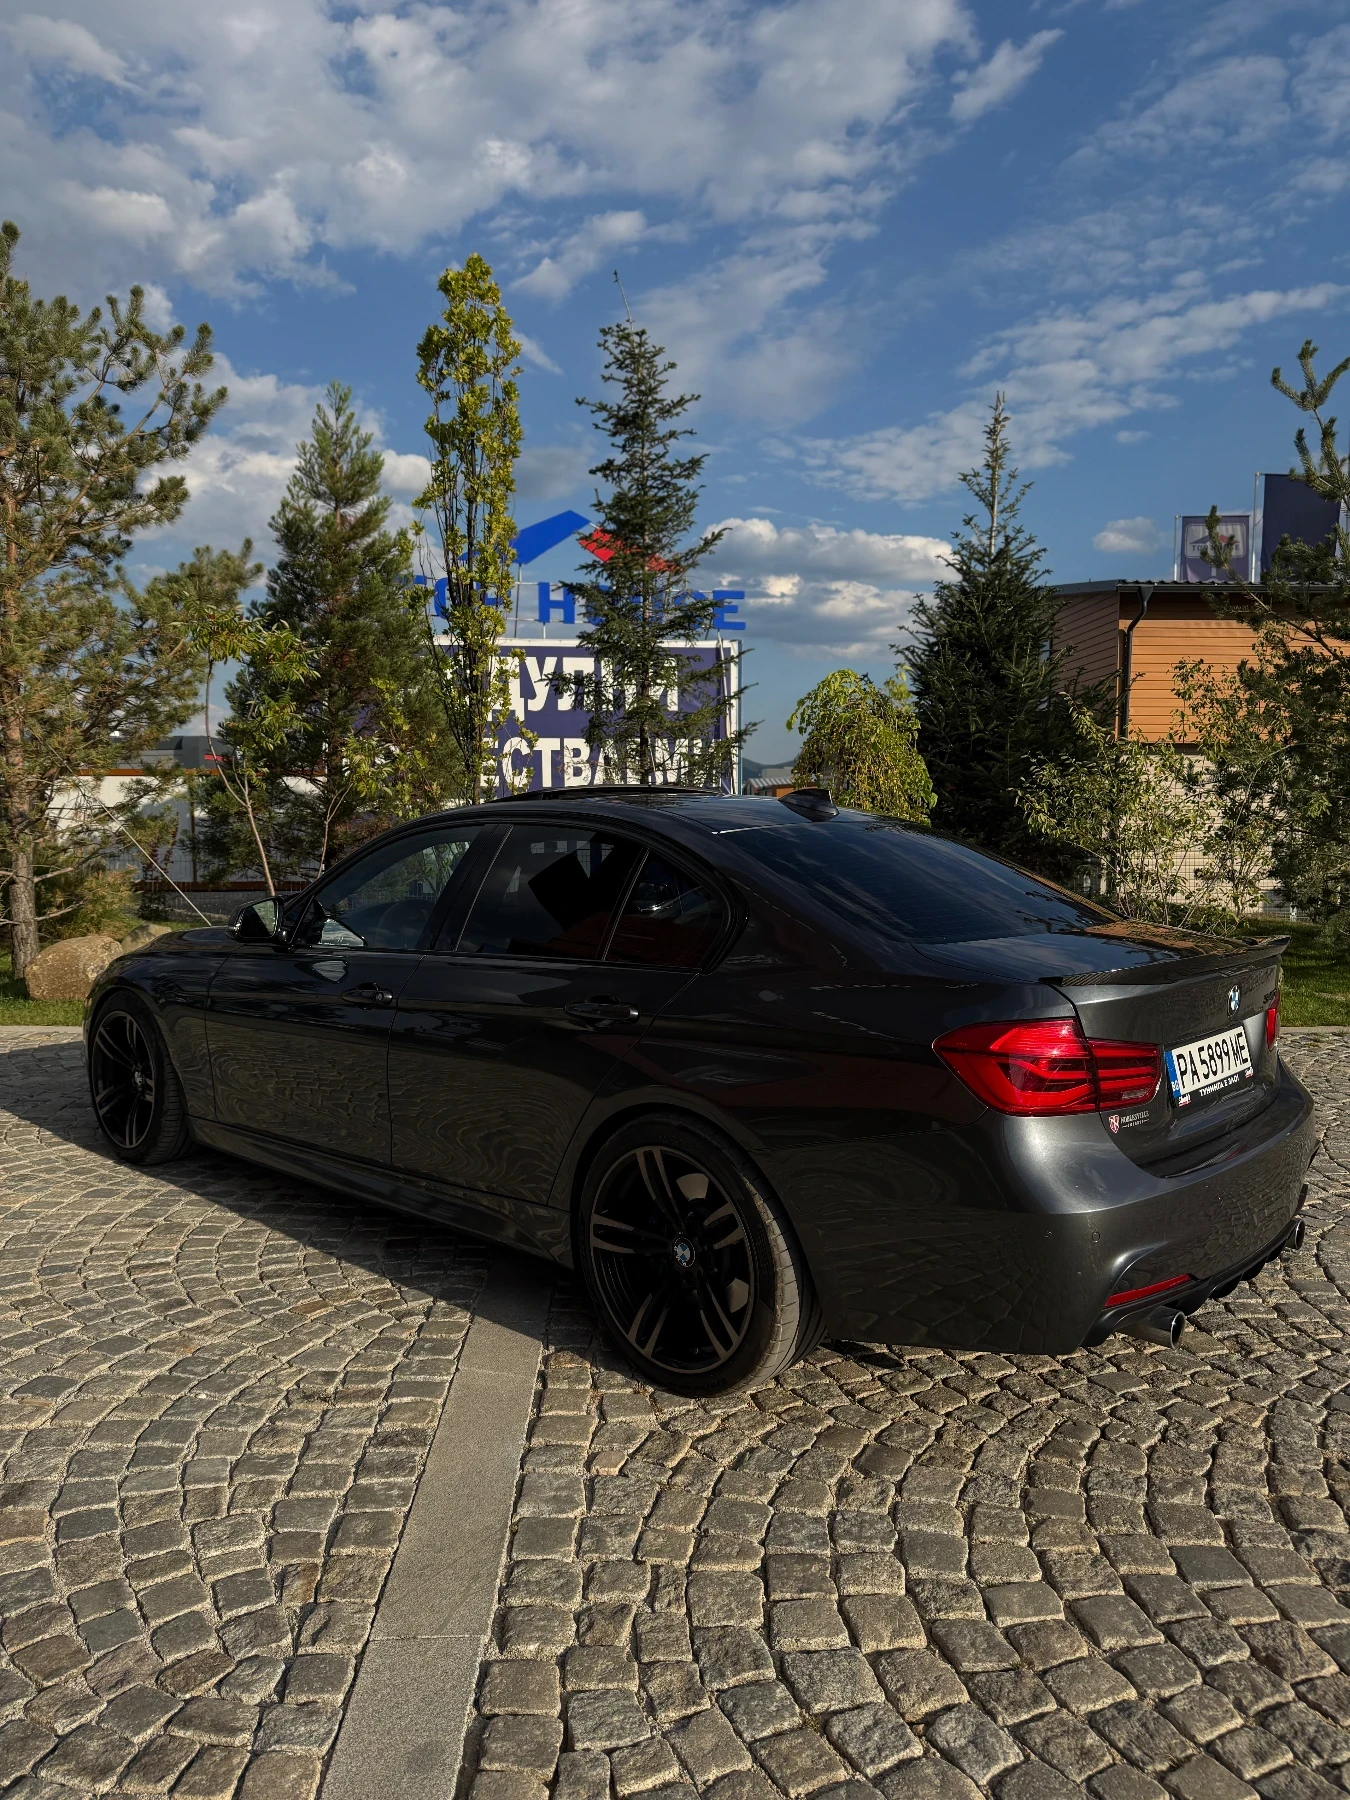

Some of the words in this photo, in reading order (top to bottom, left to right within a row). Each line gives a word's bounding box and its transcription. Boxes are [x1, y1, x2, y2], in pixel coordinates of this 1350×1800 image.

[1176, 1050, 1201, 1089] PA
[1197, 1038, 1231, 1080] 5899
[1229, 1032, 1249, 1068] ME
